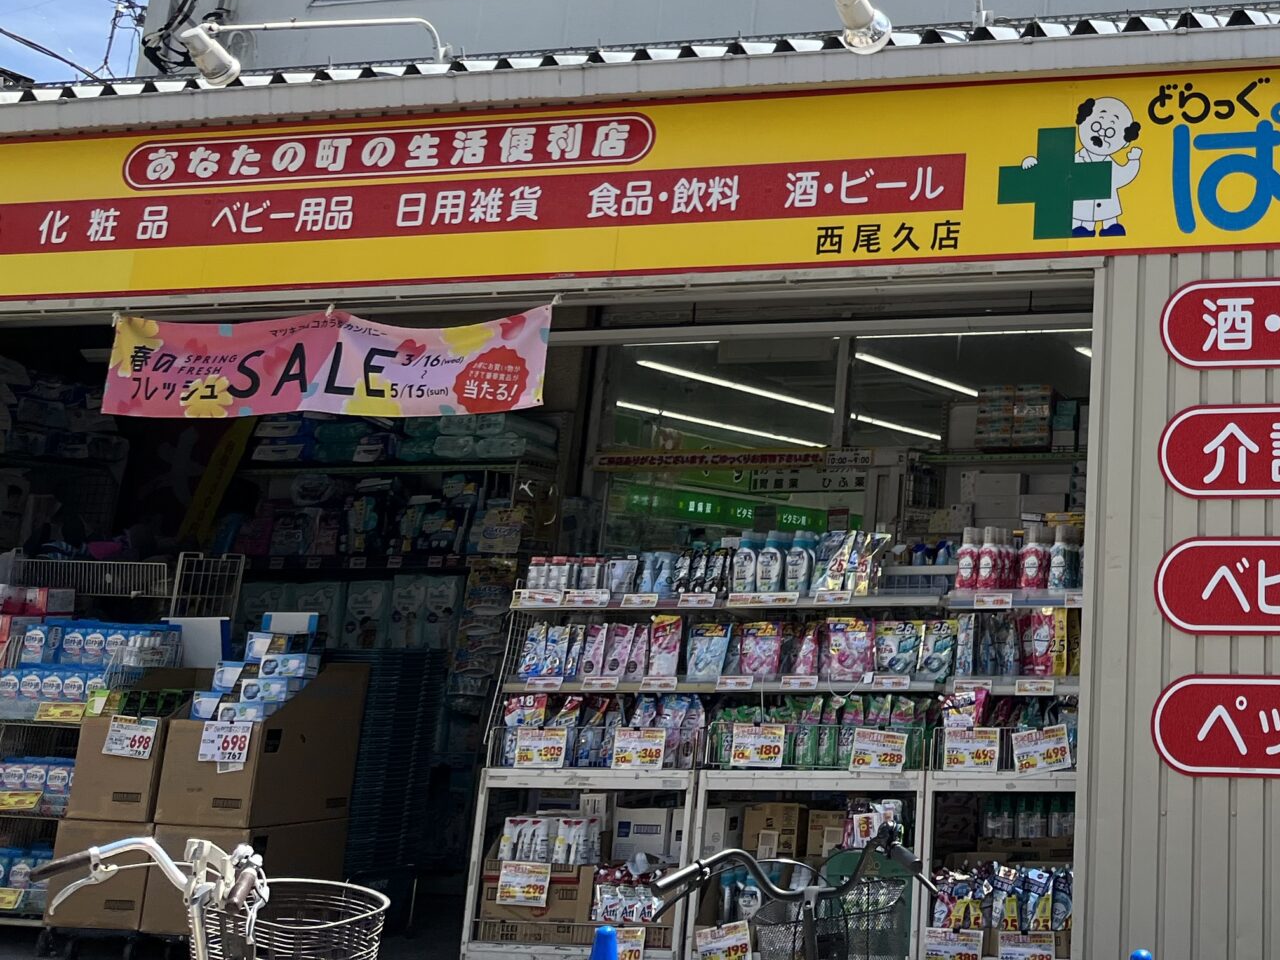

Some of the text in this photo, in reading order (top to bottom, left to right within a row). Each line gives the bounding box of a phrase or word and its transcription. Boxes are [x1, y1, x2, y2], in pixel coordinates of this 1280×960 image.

[1148, 78, 1271, 124] どらっぐ
[146, 121, 631, 180] あなたの町の生活便利店
[38, 165, 944, 246] 化粧品 ベビー用品 日用雑貨 食品・飲料 酒・ビール
[815, 220, 961, 256] 西尾久店
[130, 344, 179, 374] 春の
[177, 366, 223, 376] FRESH
[184, 353, 239, 364] SPRING
[226, 342, 399, 399] SALE
[131, 377, 219, 402] フレッシュ
[129, 734, 151, 750] 698
[221, 735, 248, 752] 698
